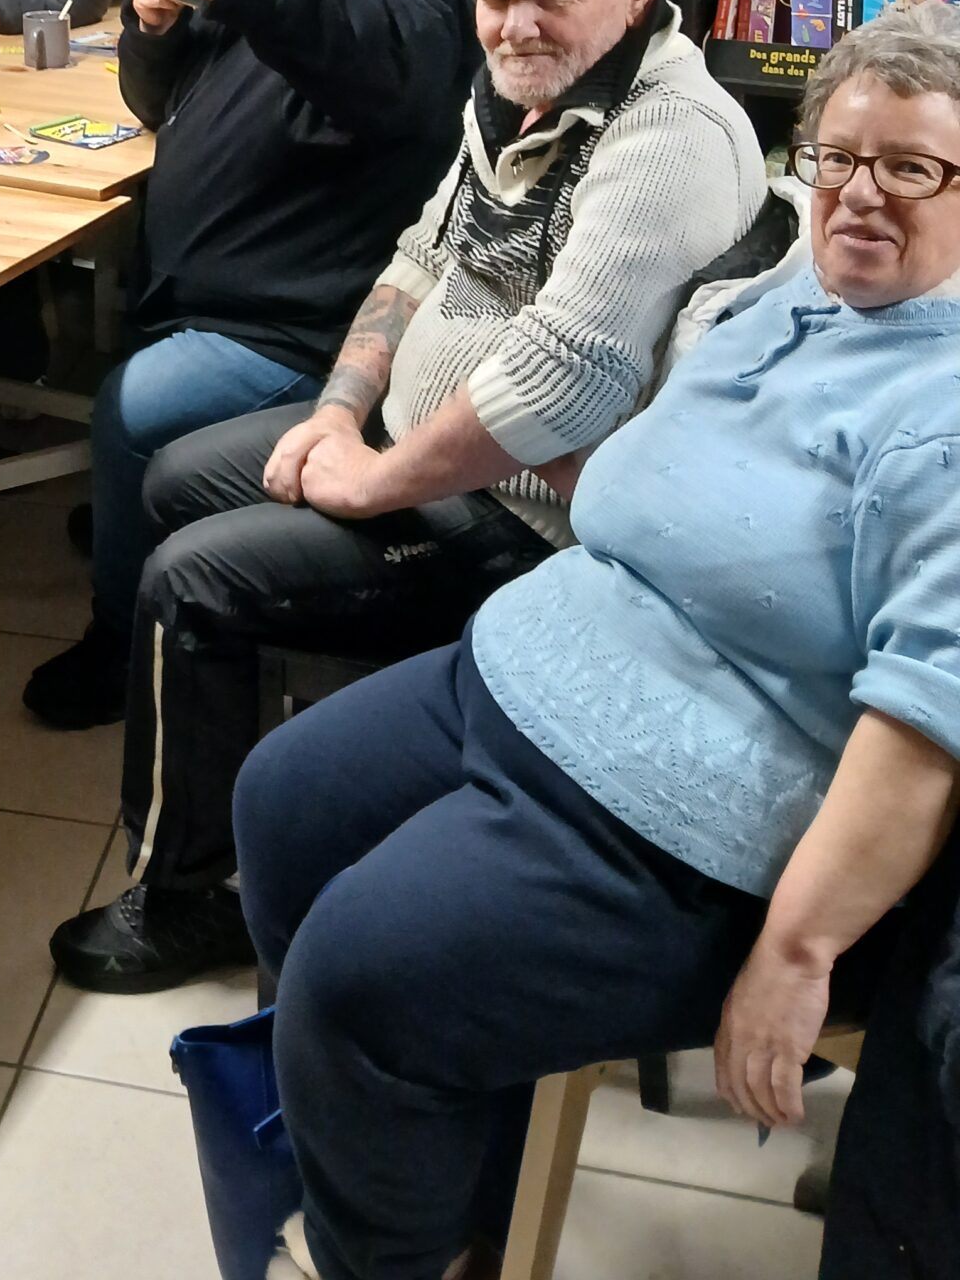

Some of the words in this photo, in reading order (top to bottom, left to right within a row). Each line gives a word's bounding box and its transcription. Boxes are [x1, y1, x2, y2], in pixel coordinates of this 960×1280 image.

[769, 49, 816, 65] grands
[761, 63, 785, 75] dans
[786, 65, 805, 77] des
